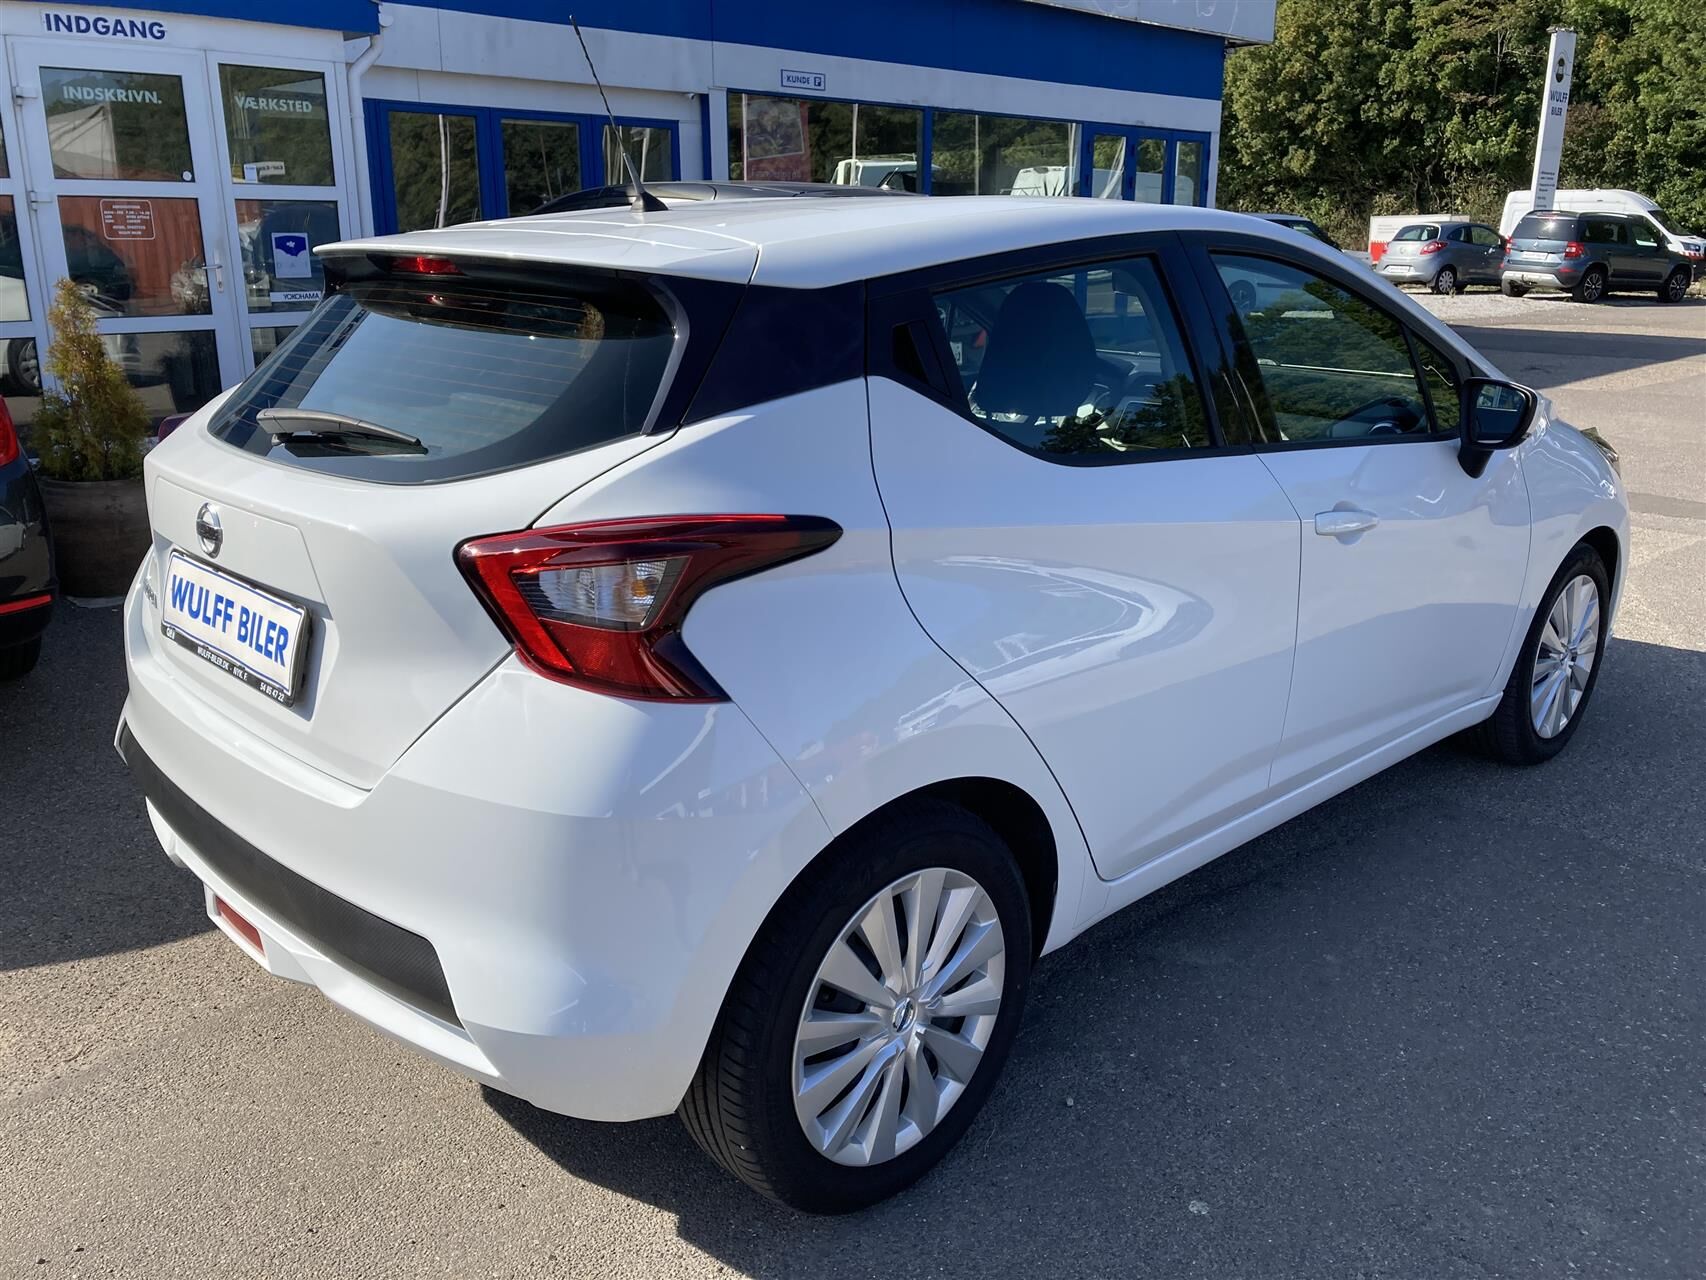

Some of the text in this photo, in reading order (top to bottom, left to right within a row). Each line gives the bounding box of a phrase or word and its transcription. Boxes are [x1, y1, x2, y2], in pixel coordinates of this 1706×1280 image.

[44, 13, 166, 40] INDGANG
[786, 75, 810, 85] KUNDE
[62, 85, 162, 105] INDSKRIVN.
[234, 95, 313, 113] VÆRKSTED
[1550, 89, 1568, 104] WULFF
[283, 292, 320, 300] YOKOHAMA
[171, 574, 235, 633] WULFF
[237, 605, 289, 667] BILER
